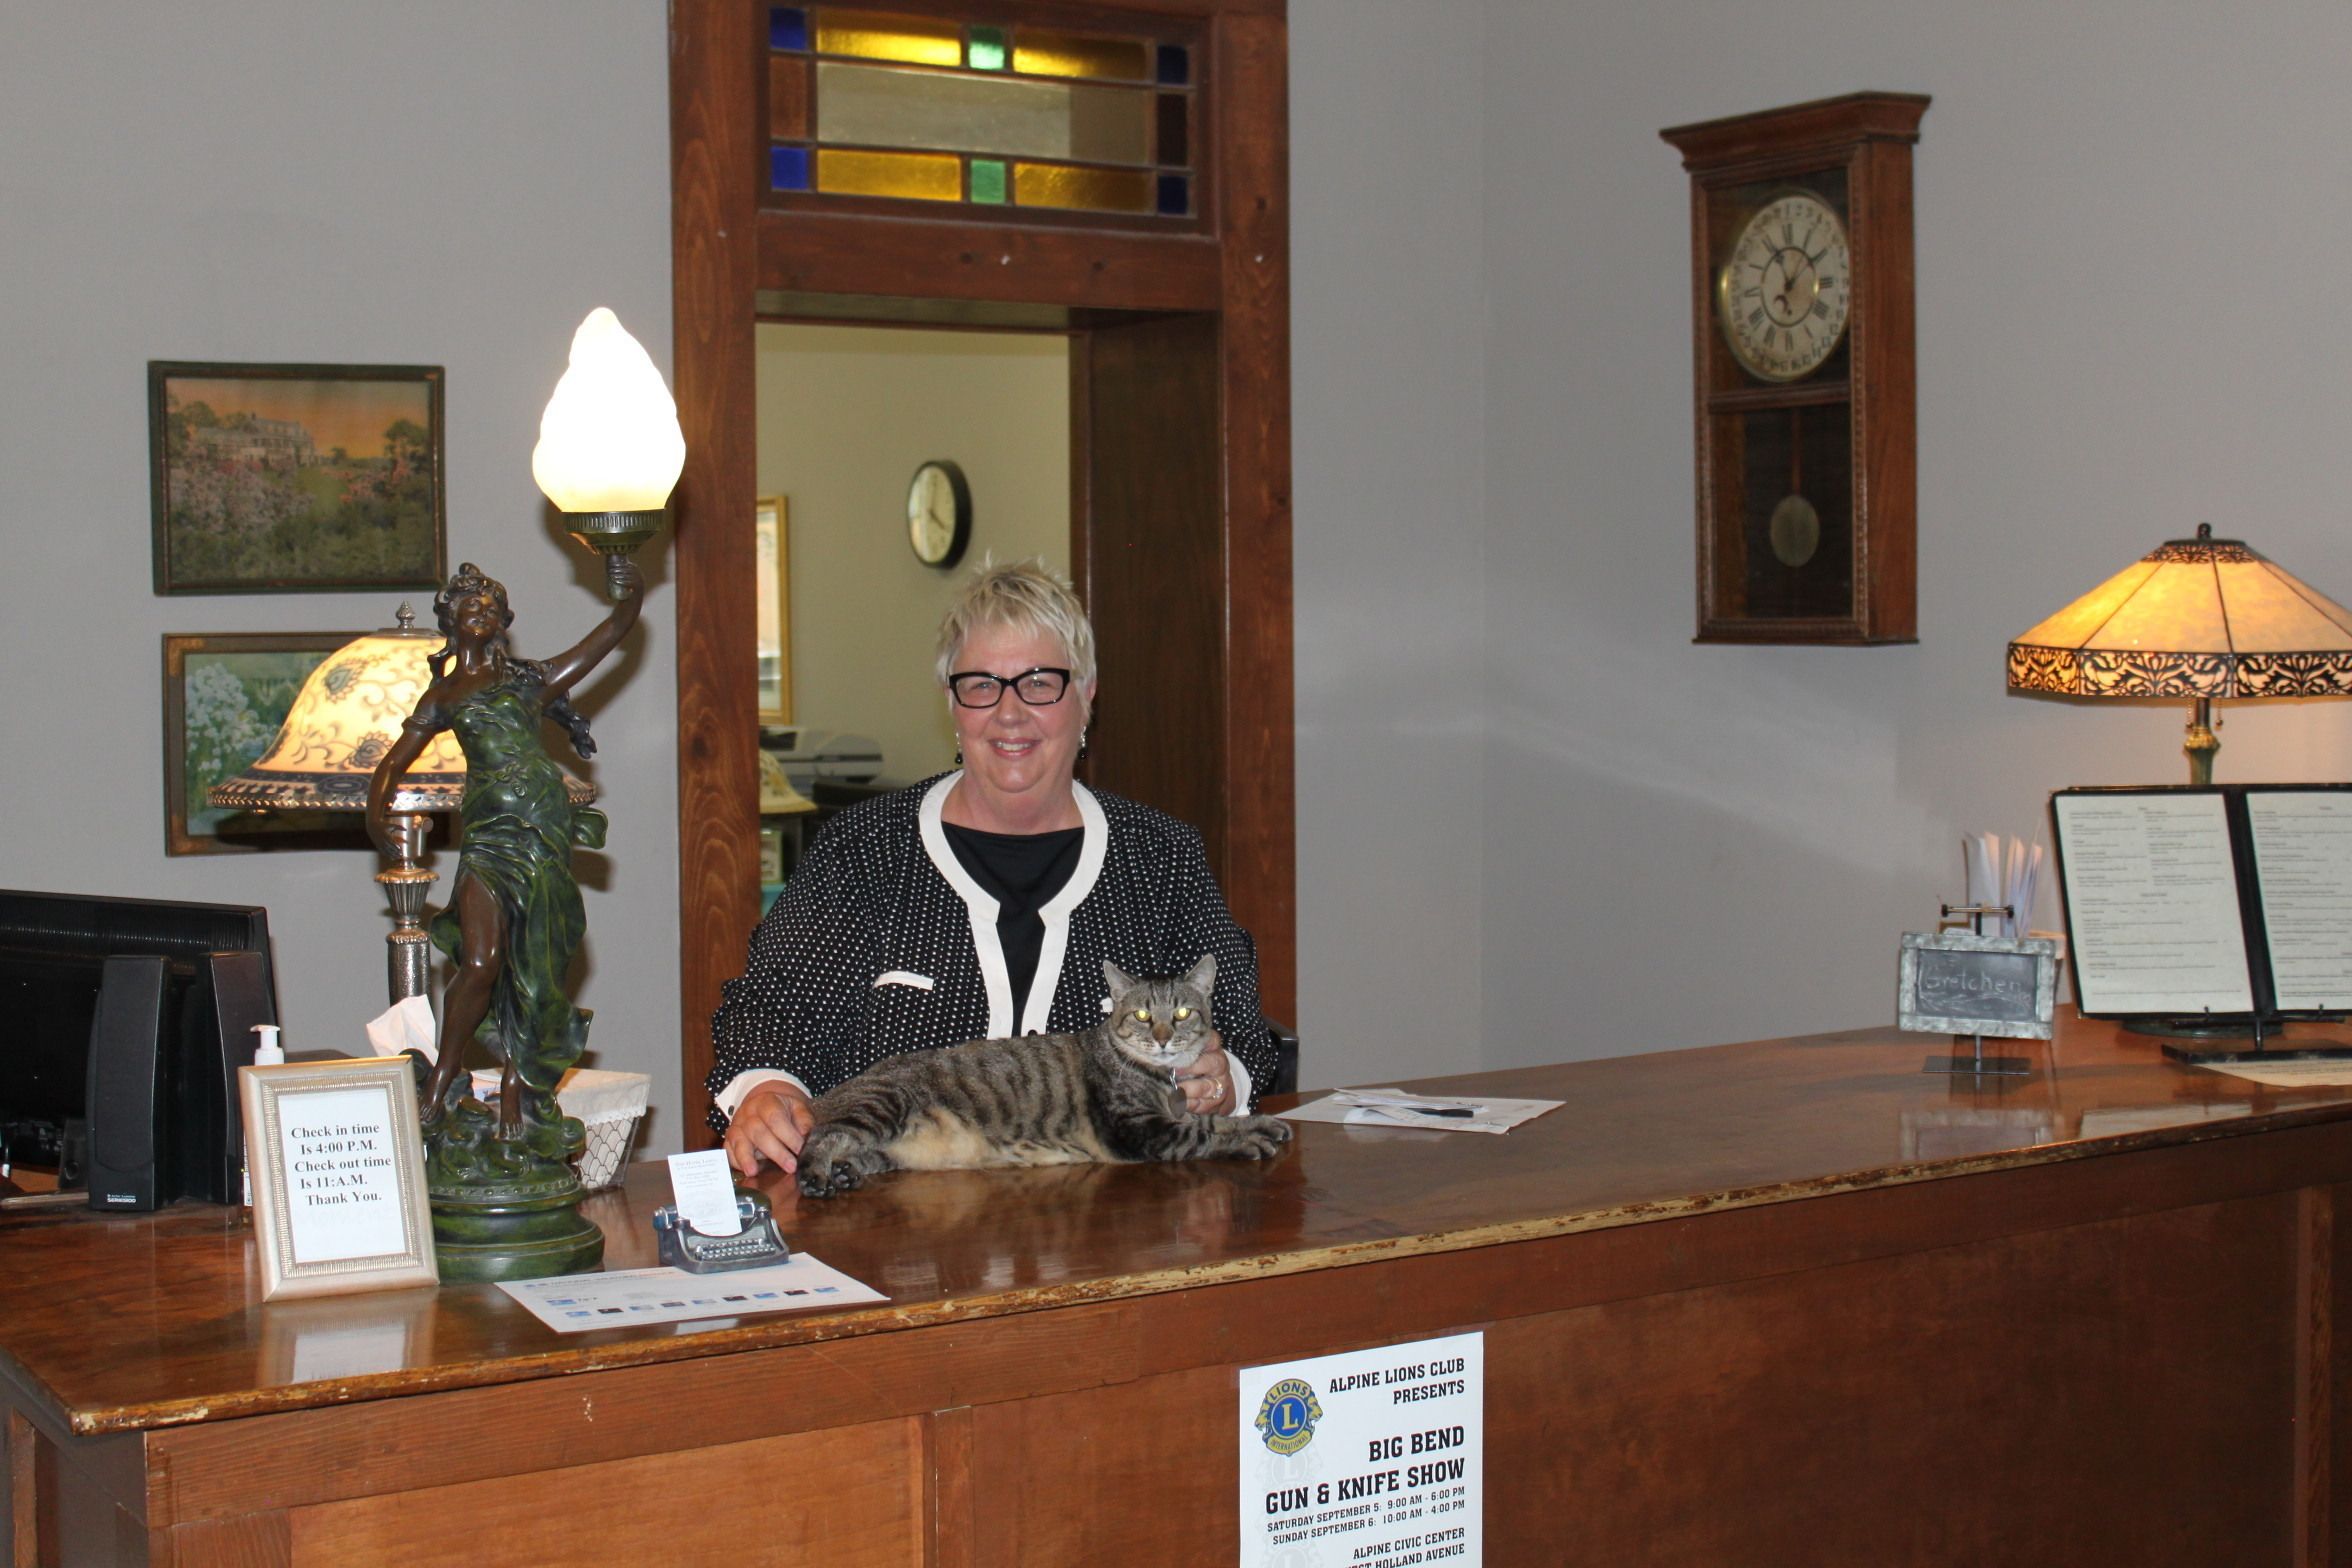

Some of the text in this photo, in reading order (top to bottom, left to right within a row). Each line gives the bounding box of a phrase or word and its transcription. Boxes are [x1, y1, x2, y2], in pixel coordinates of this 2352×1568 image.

[291, 1123, 380, 1139] Check in time
[301, 1139, 378, 1155] Is 4:00 P.M.
[294, 1156, 392, 1173] Check out time
[301, 1174, 368, 1190] Is 11:A.M.
[306, 1191, 382, 1206] Thank You.
[1329, 1358, 1465, 1393] ALPINE LIONS CLUB
[1269, 1382, 1308, 1401] LIONS
[1393, 1379, 1465, 1405] PRESENTS
[1282, 1403, 1299, 1430] L
[1270, 1434, 1309, 1451] INTERNATIONAL
[1369, 1425, 1465, 1462] BIG BEND
[1266, 1458, 1465, 1514] GUN & KNIFE SHOW
[1267, 1515, 1314, 1532] SATURDAY
[1317, 1504, 1371, 1523] SEPTEMBER
[1387, 1497, 1407, 1509] 9:00
[1409, 1494, 1422, 1505] AM
[1431, 1489, 1450, 1501] 6:00
[1453, 1486, 1465, 1496] PM
[1273, 1530, 1309, 1545] SUNDAY
[1311, 1519, 1366, 1538] SEPTEMBER
[1383, 1511, 1407, 1524] 10:00
[1409, 1508, 1422, 1519] AM
[1431, 1503, 1450, 1515] 4:00
[1453, 1499, 1465, 1510] PM
[1353, 1527, 1465, 1559] ALPINE CIVIC CENTER
[1375, 1543, 1465, 1568] HOLLAND AVENUE
